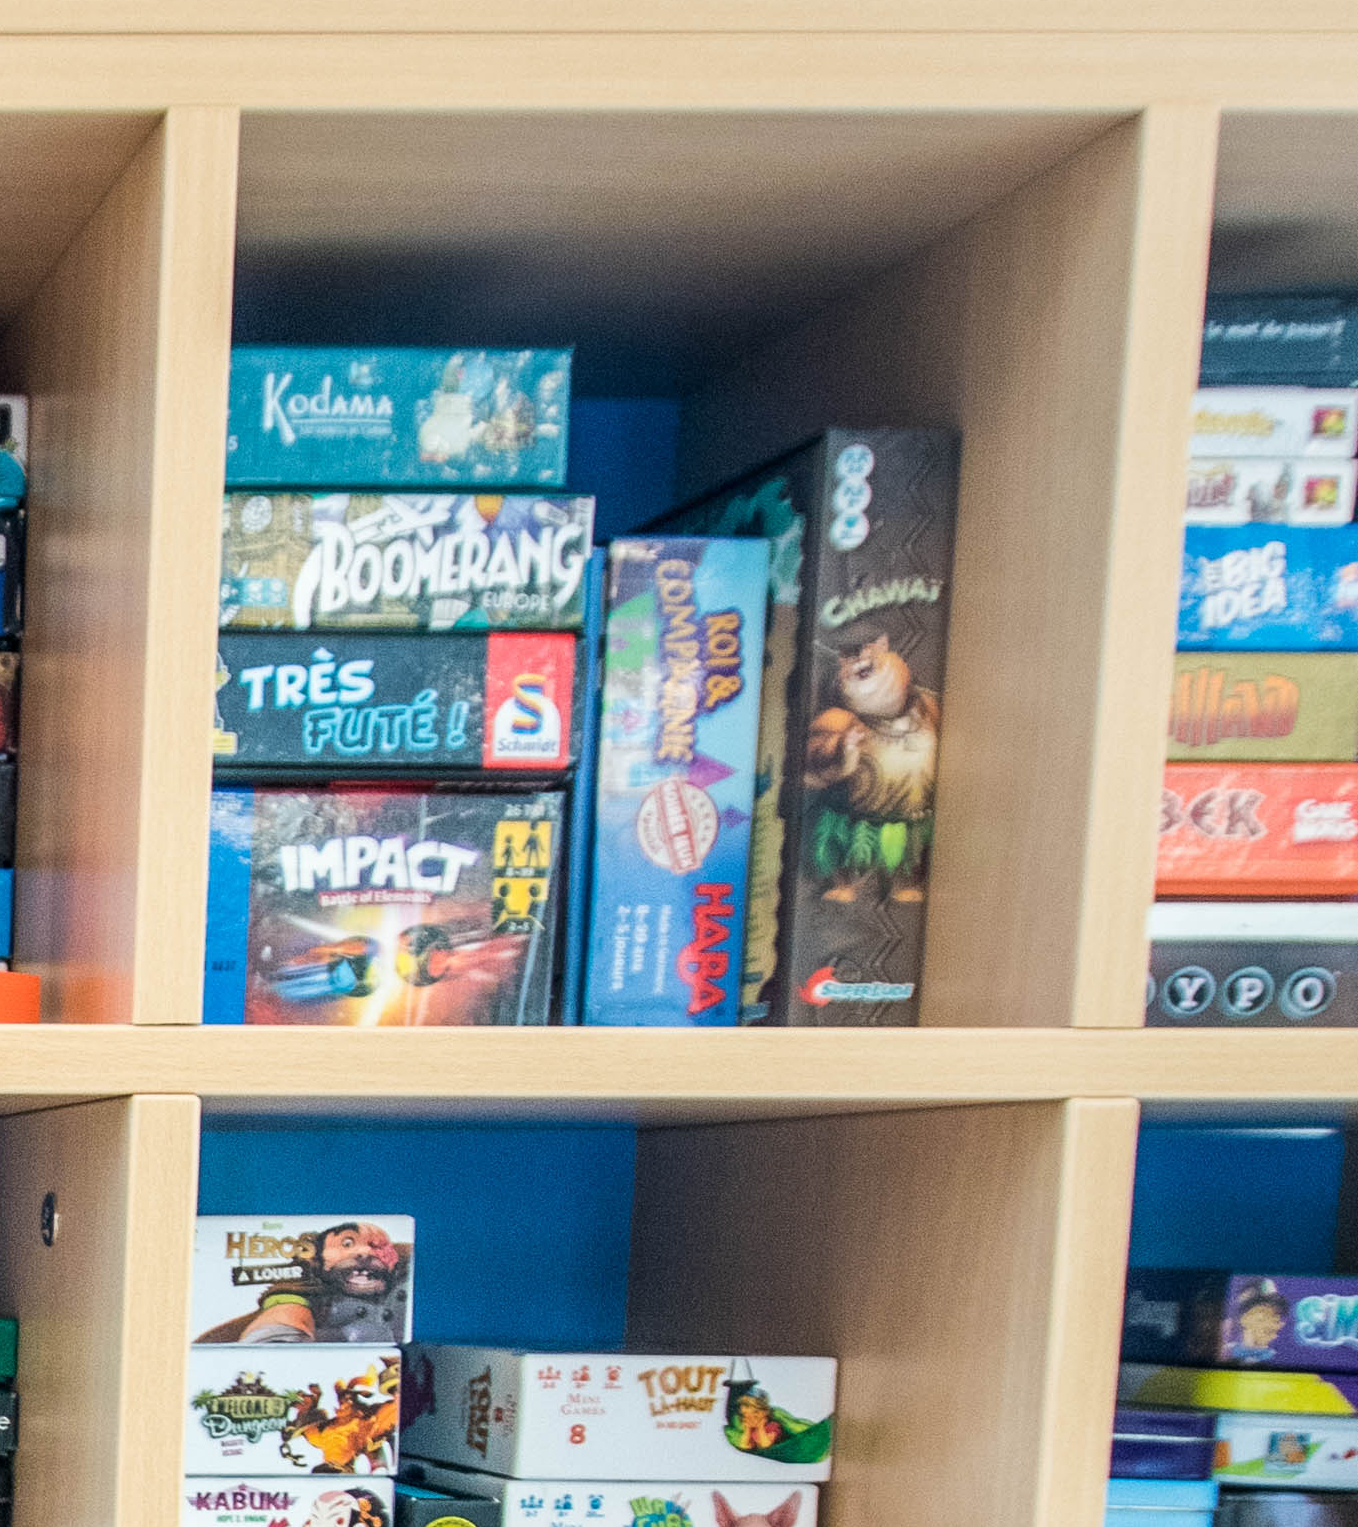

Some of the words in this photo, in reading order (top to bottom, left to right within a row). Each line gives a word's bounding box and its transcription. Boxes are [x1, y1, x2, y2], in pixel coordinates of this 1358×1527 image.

[293, 521, 587, 631] BOOMERANG
[704, 611, 743, 671] ROI
[239, 646, 376, 712] TRÈS
[303, 691, 438, 756] FUTÉ
[276, 837, 478, 896] IMPACT
[680, 882, 735, 1017] HABA
[638, 1366, 725, 1397] TOUT
[194, 1490, 290, 1513] KABUKI
